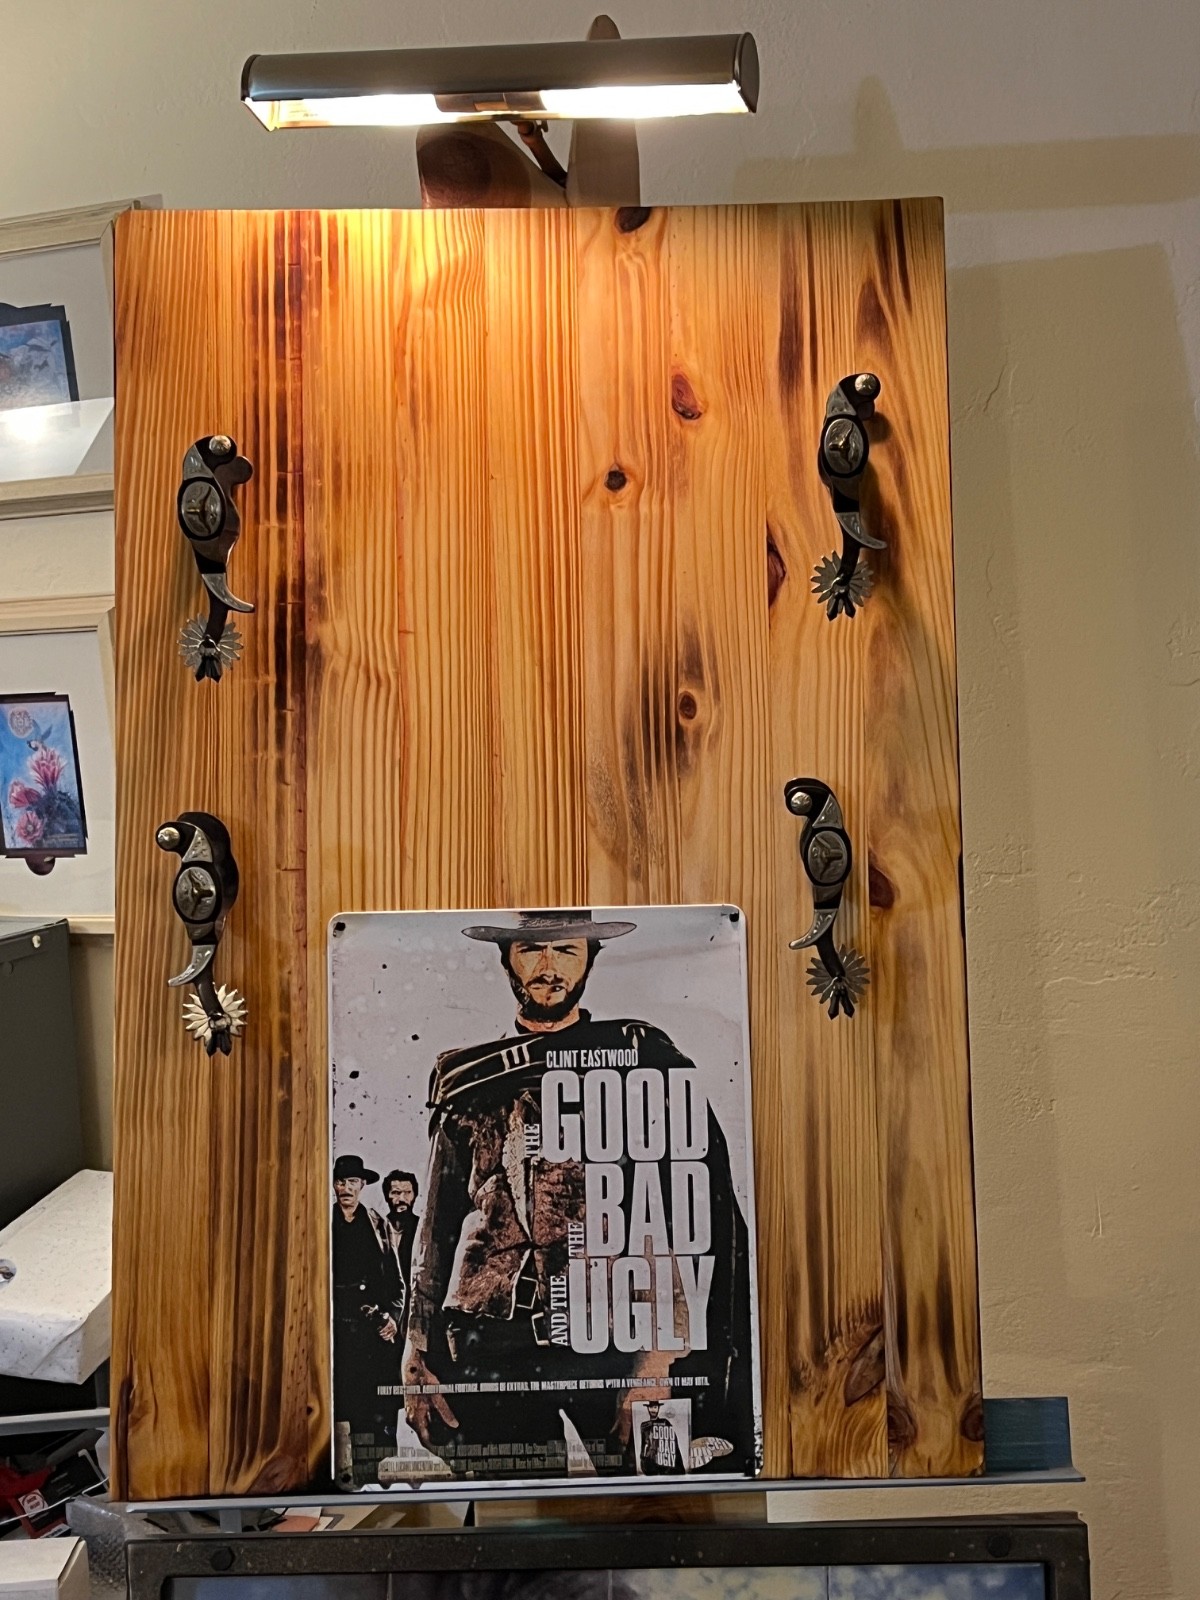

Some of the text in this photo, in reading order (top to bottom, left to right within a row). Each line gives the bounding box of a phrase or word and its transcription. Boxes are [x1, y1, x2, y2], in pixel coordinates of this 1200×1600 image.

[546, 1049, 639, 1068] CLINT EASTWOOD
[524, 1123, 540, 1158] THE
[541, 1067, 709, 1162] GOOD
[568, 1222, 584, 1257] THE
[585, 1161, 711, 1257] BAD
[550, 1275, 569, 1346] AND THE
[569, 1255, 715, 1354] UGLY
